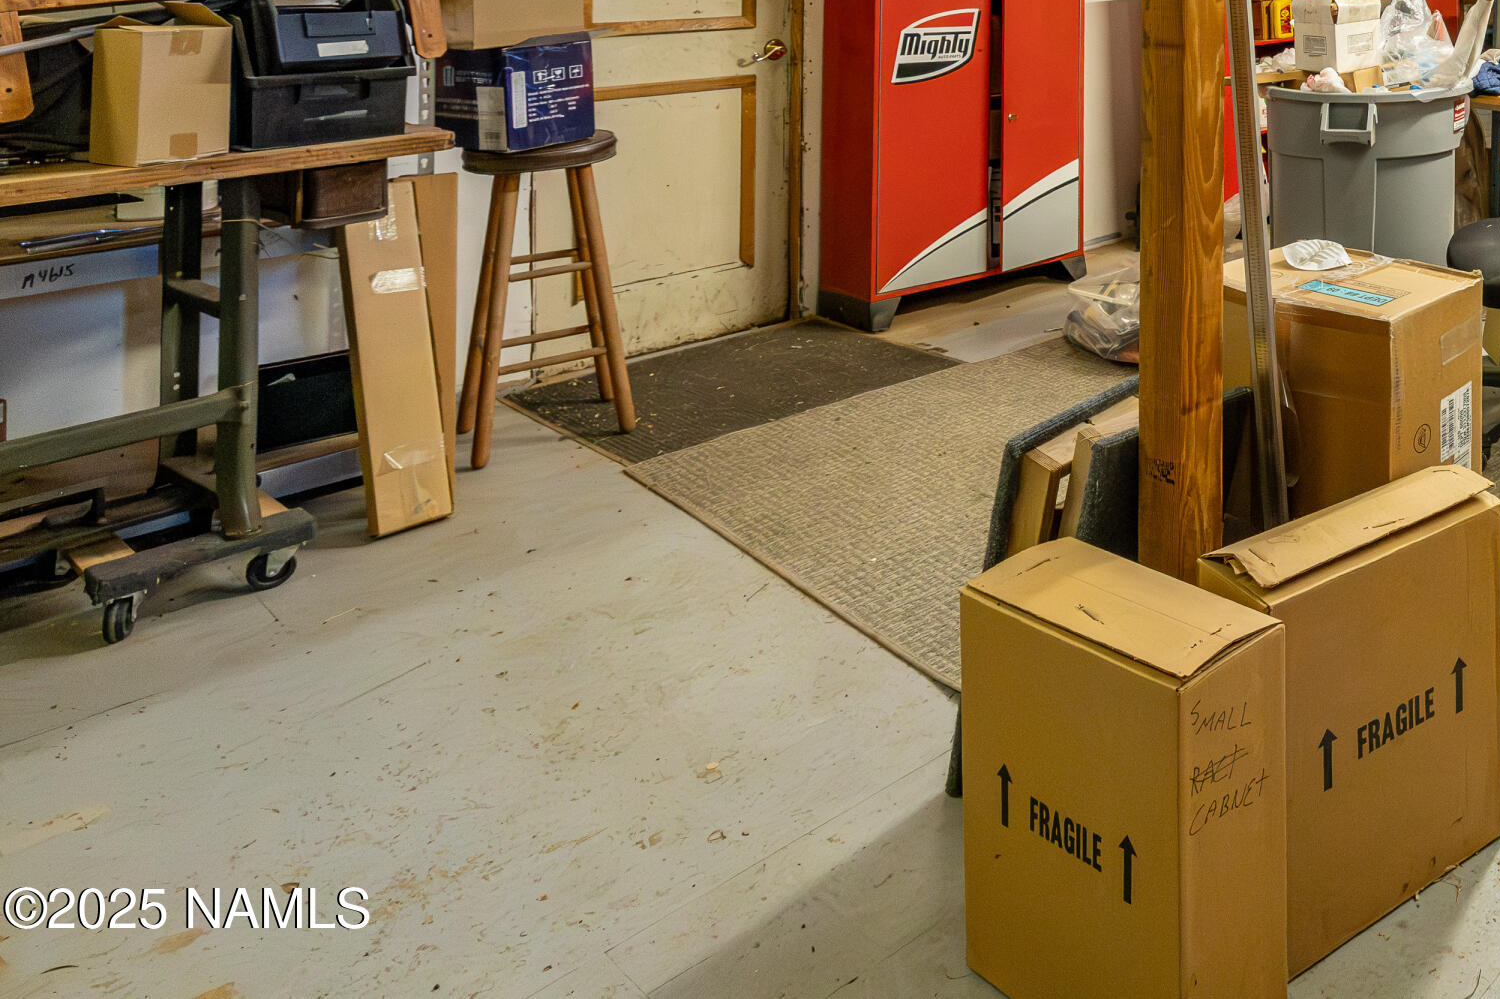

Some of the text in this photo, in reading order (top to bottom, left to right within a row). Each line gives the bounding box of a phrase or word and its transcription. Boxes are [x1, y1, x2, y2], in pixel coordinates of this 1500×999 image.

[900, 30, 972, 60] Mighty
[1190, 699, 1252, 735] SMALL
[1357, 686, 1436, 760] FRAGILE
[1029, 795, 1103, 873] FRAGILE
